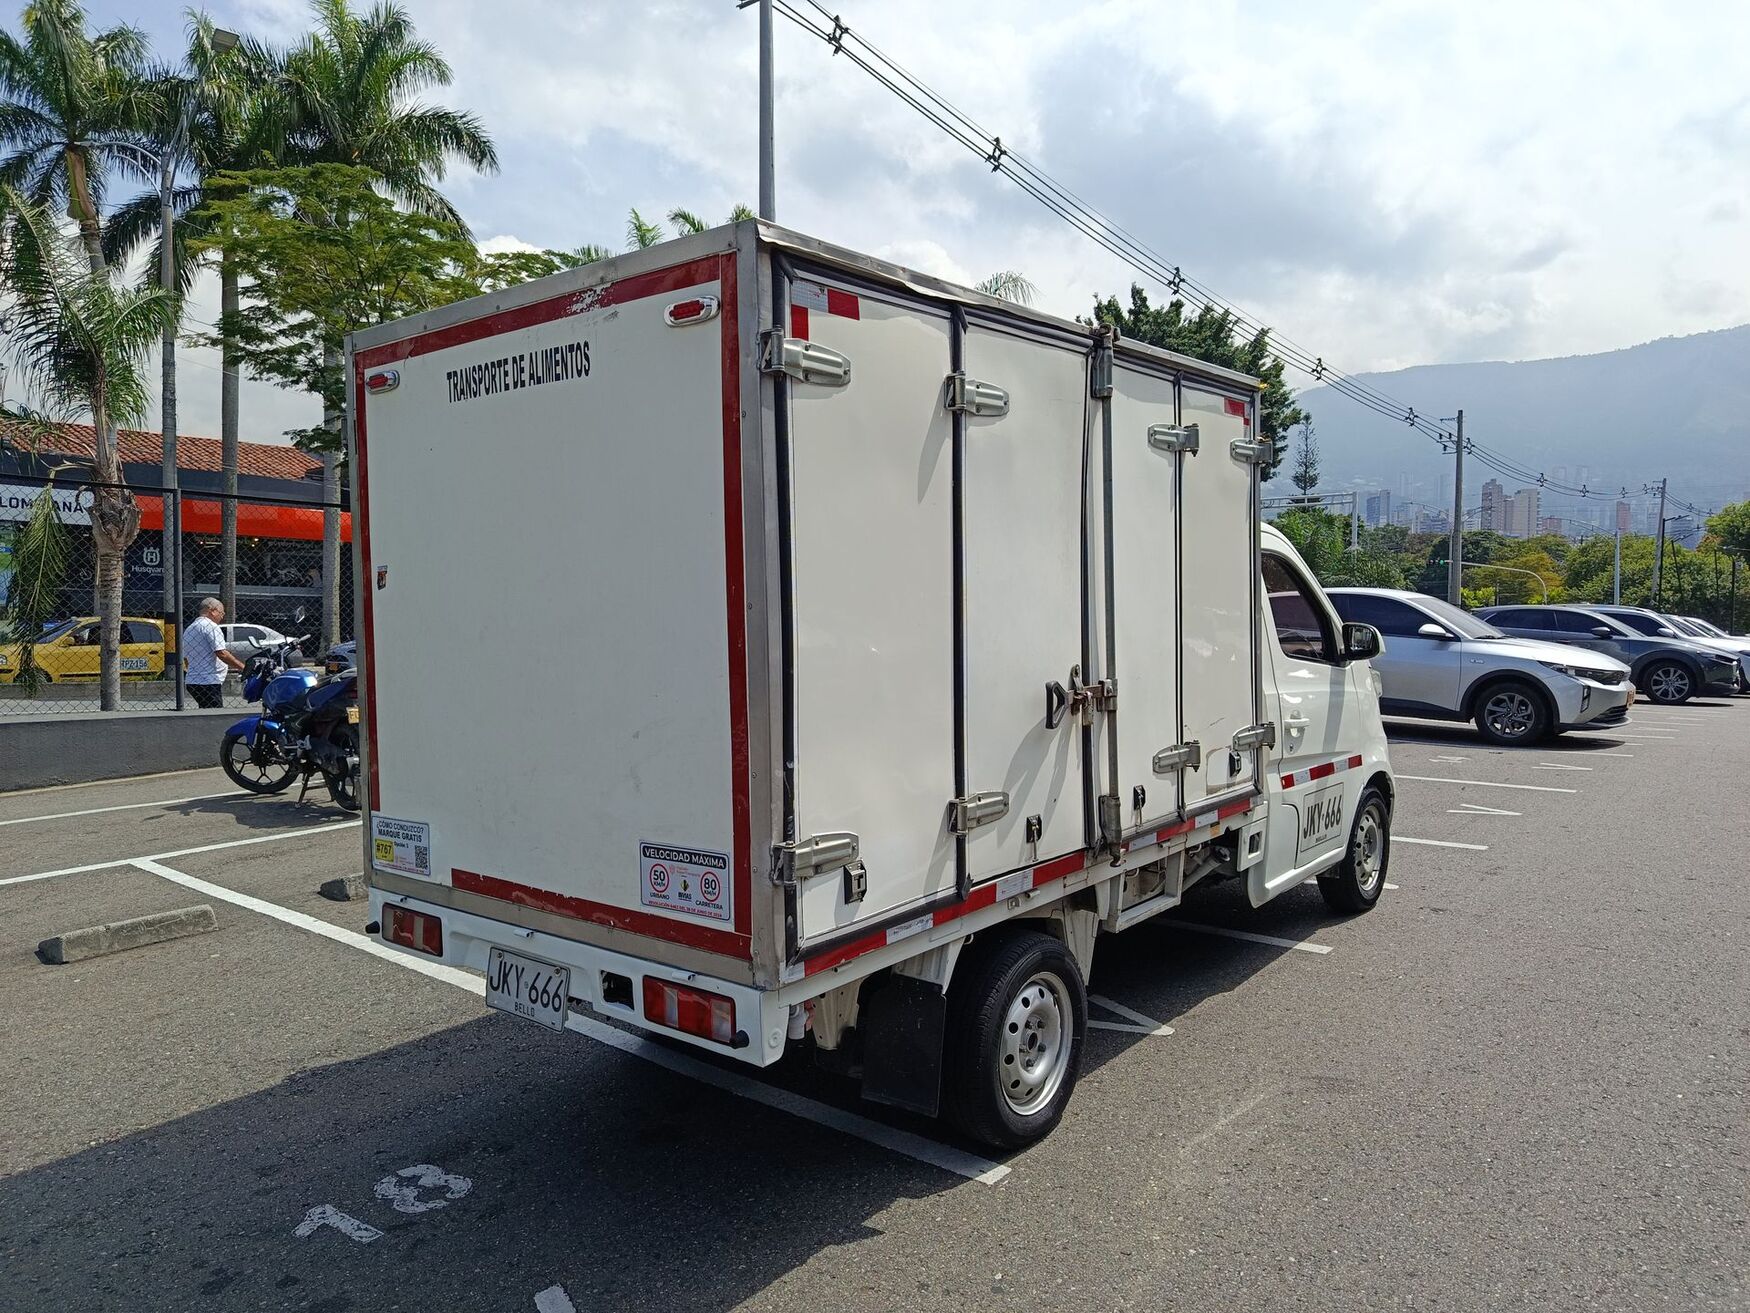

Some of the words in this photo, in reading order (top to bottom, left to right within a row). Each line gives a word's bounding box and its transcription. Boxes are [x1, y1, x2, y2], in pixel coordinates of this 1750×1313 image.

[446, 357, 510, 403] TRANSPORTE
[512, 354, 526, 390] DE
[528, 340, 591, 387] ALIMENTOS
[394, 822, 424, 834] CONDUZCO?
[378, 828, 401, 839] MARQUE
[401, 832, 422, 843] GRATIS
[376, 842, 392, 854] #767
[644, 847, 690, 862] VELOCIDAD
[691, 853, 724, 868] MÁXIMA
[653, 869, 666, 881] 50
[703, 878, 717, 890] 80
[649, 892, 670, 900] URBANO
[695, 899, 724, 911] CARRETERA
[514, 1001, 535, 1017] BELLO
